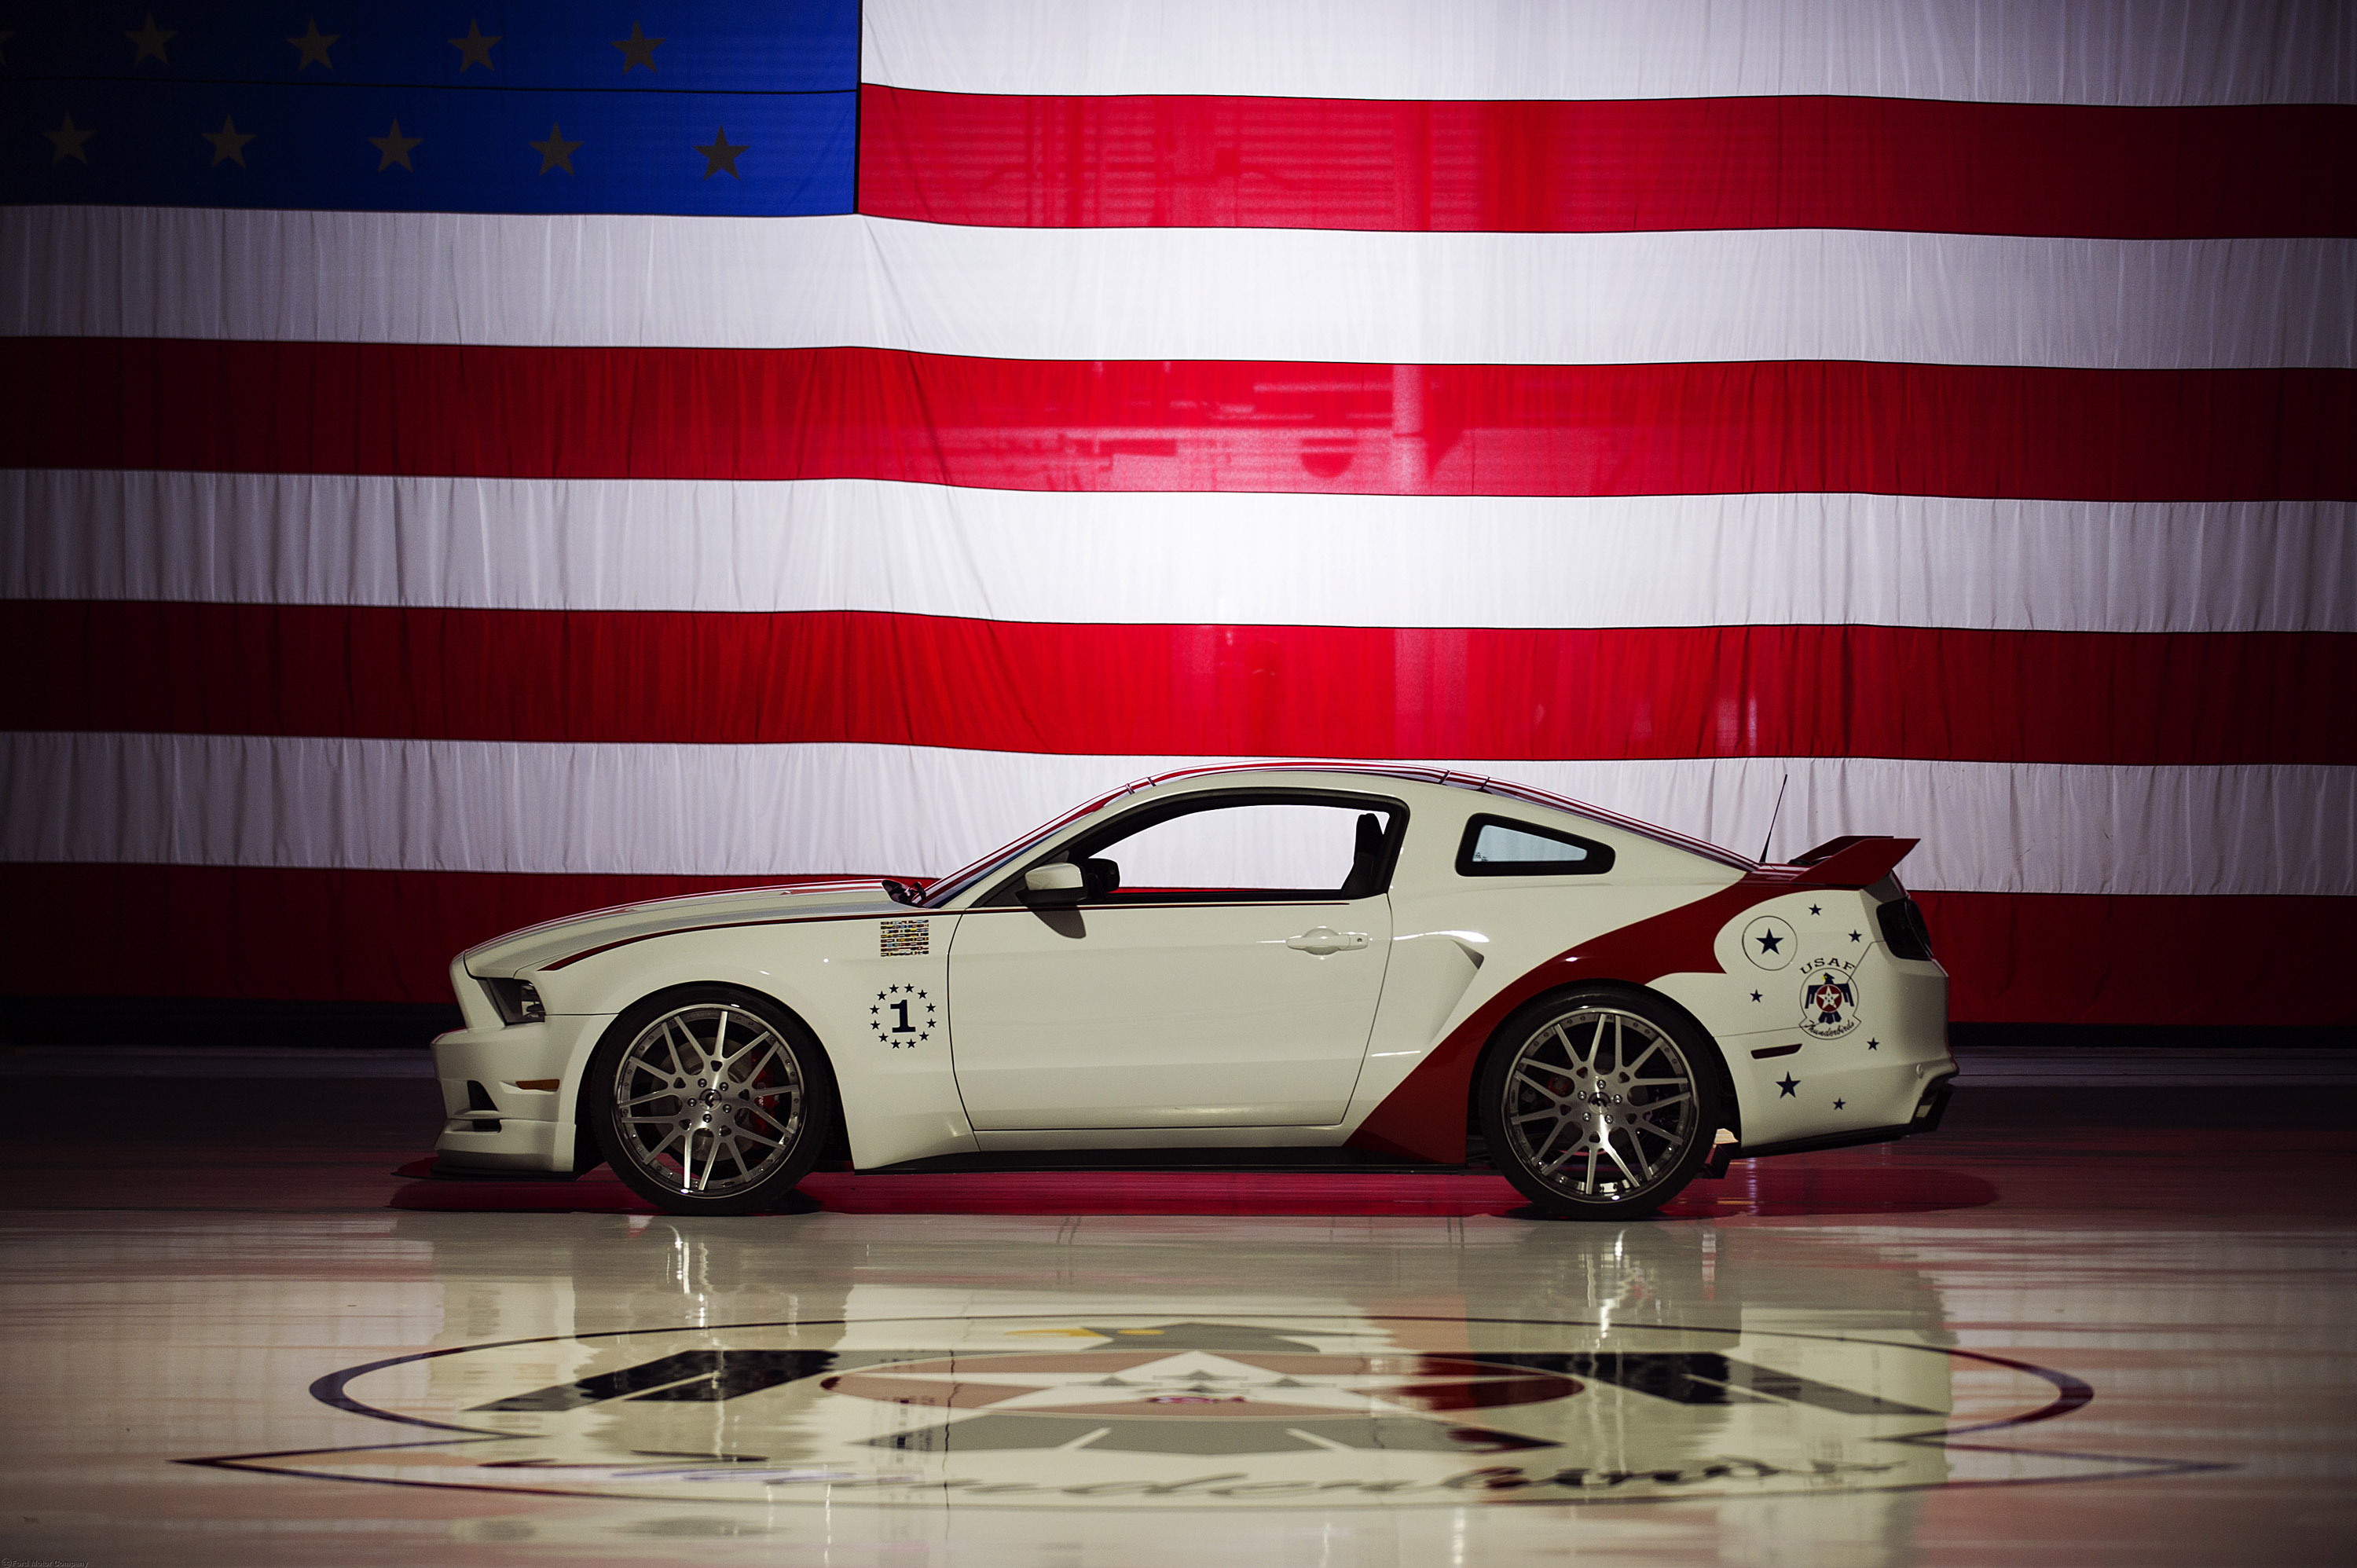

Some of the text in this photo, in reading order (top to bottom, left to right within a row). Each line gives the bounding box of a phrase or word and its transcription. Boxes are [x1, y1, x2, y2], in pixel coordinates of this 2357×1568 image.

[1800, 958, 1855, 974] USAF
[890, 999, 916, 1033] 1
[1805, 1019, 1854, 1037] Thunderbirds
